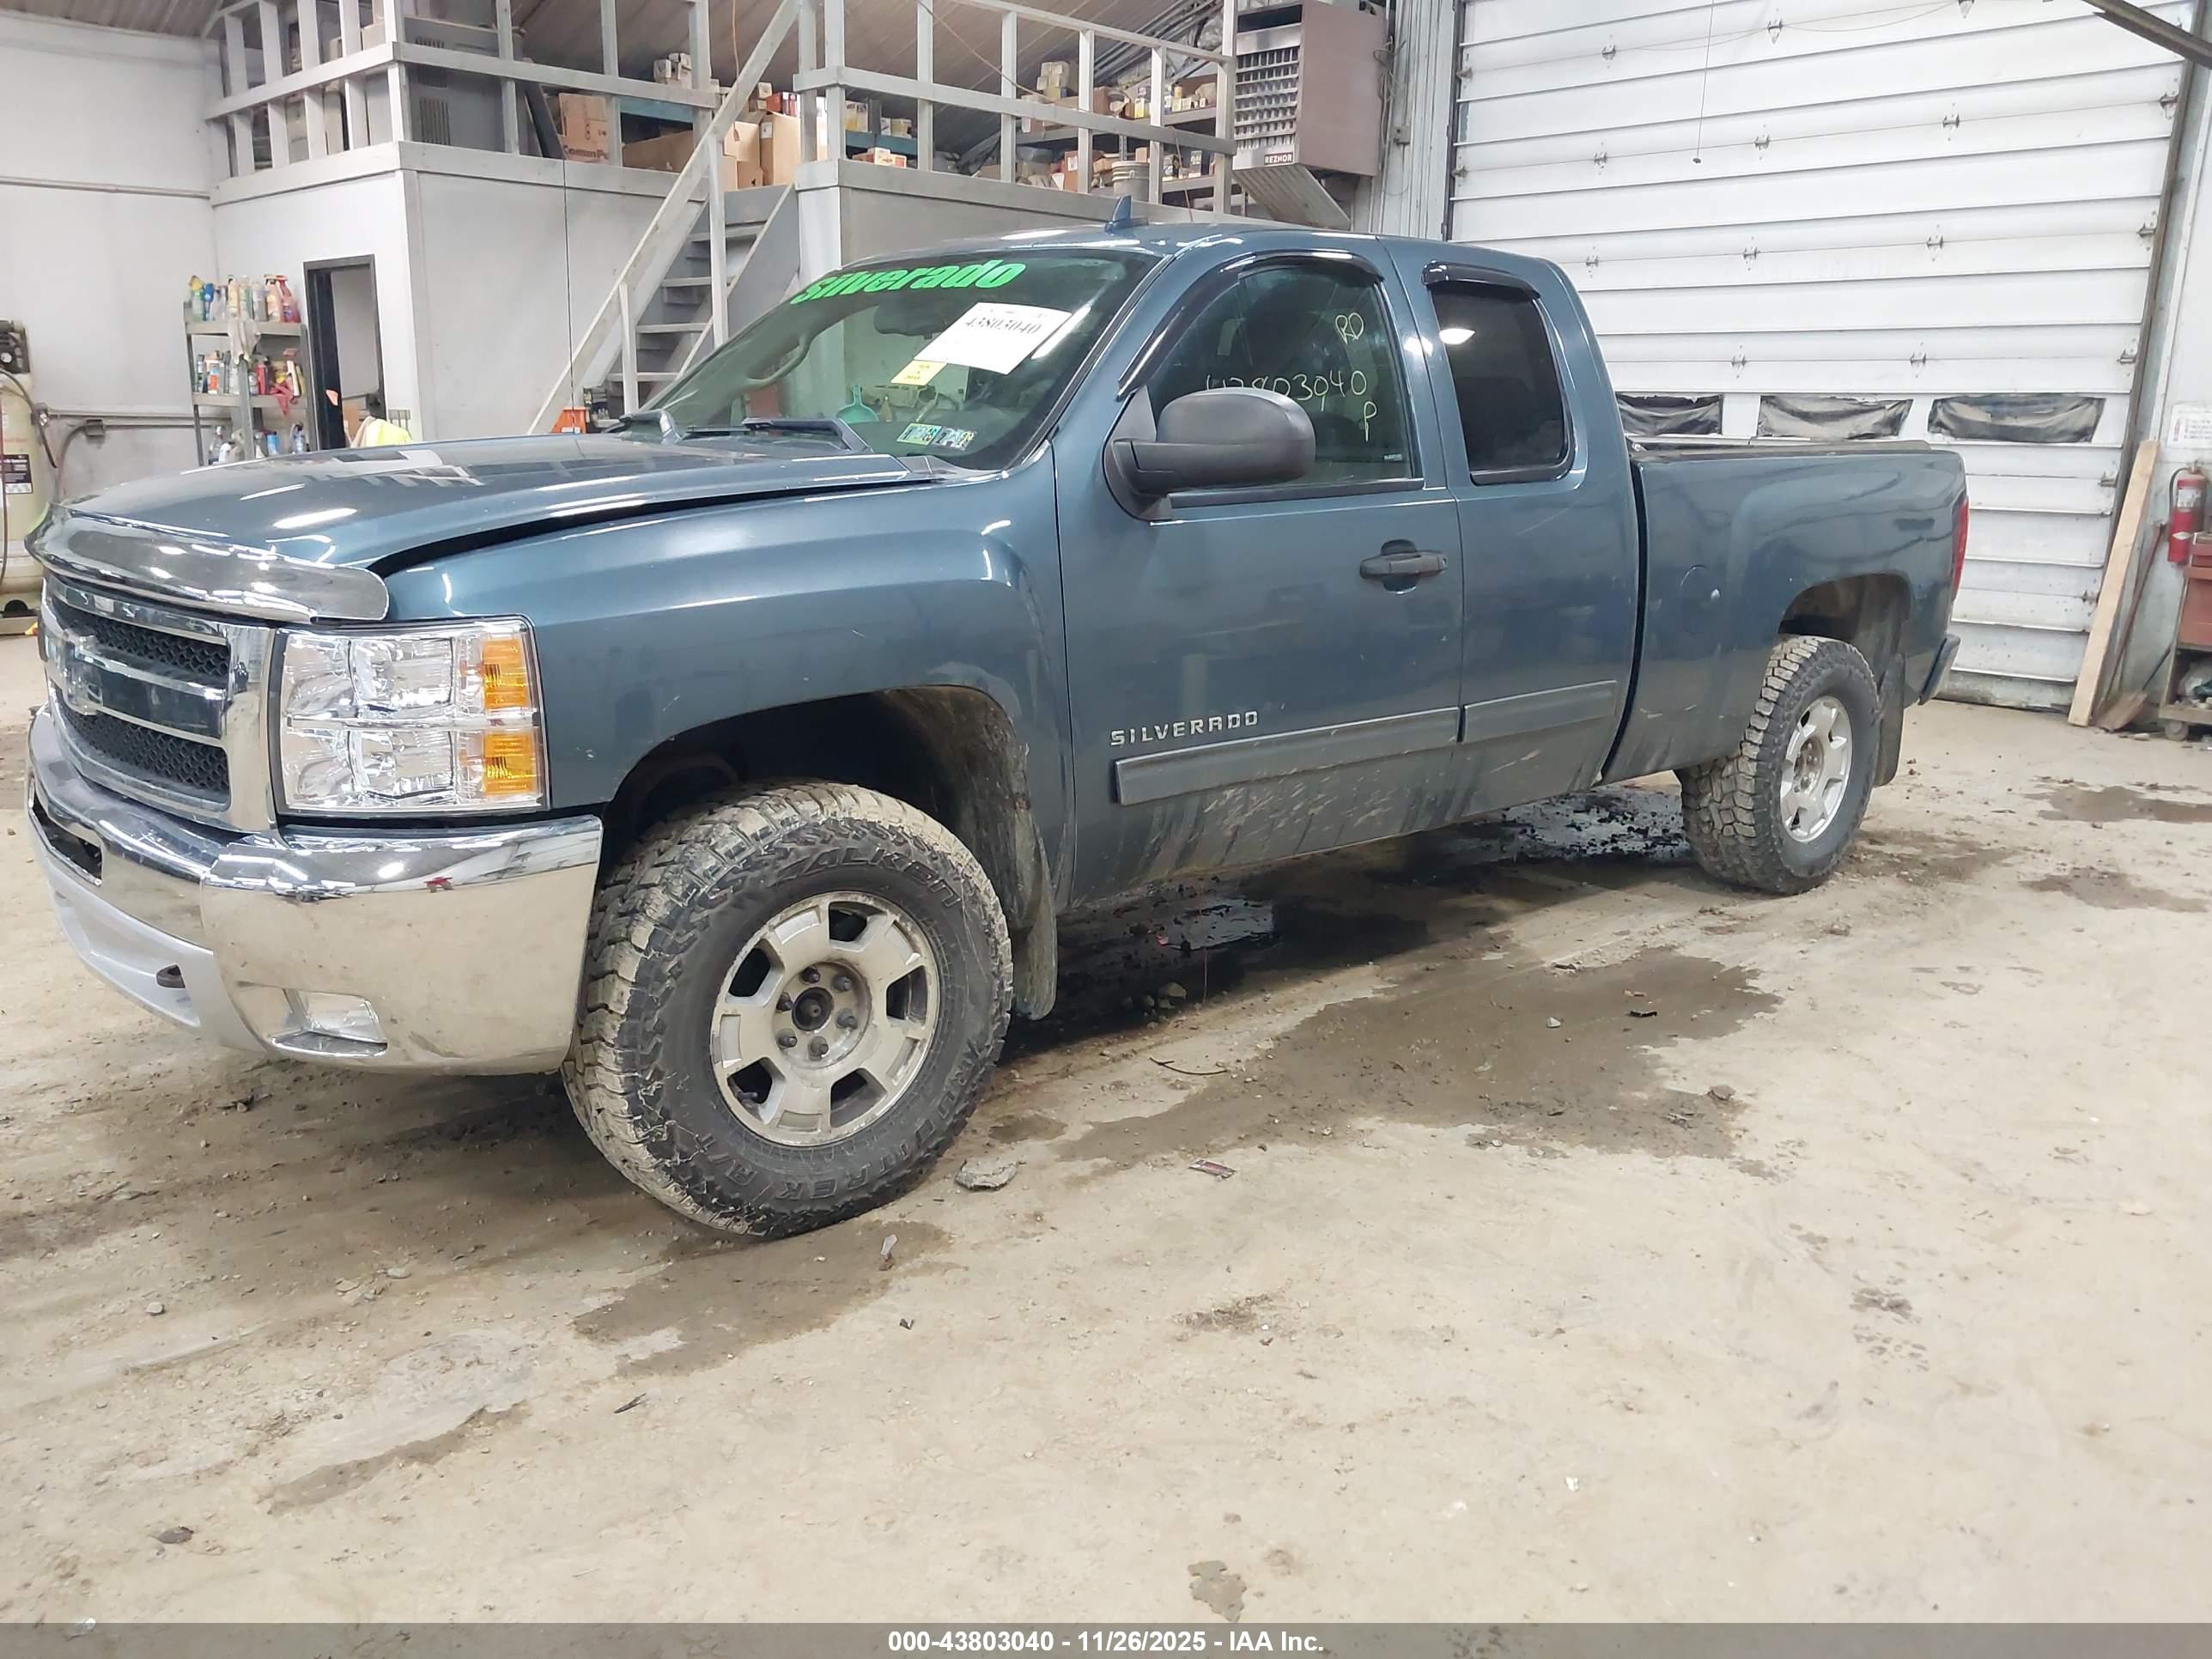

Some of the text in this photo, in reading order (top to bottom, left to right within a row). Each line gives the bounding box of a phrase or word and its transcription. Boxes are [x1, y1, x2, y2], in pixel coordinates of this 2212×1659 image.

[1264, 154, 1292, 164] REZNOR
[1364, 401, 1377, 442] P
[1110, 710, 1258, 746] SILVERADO
